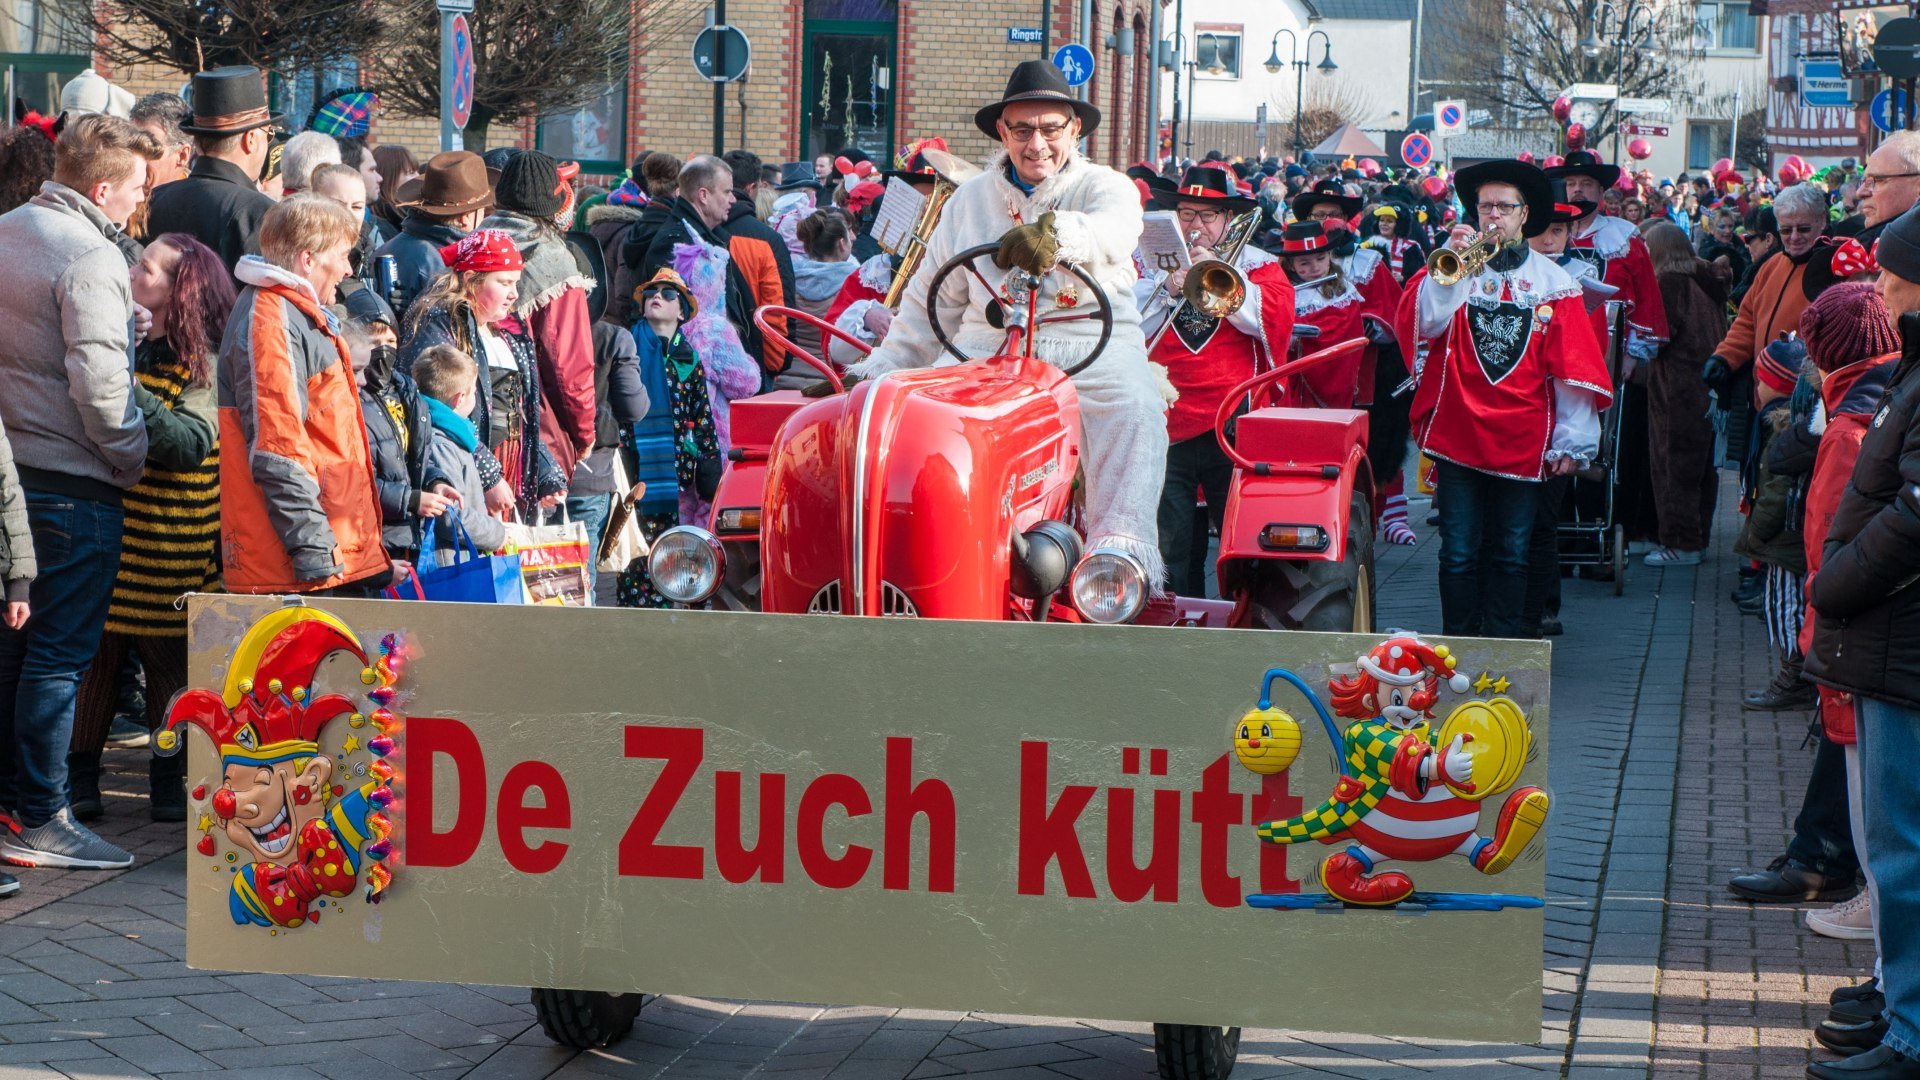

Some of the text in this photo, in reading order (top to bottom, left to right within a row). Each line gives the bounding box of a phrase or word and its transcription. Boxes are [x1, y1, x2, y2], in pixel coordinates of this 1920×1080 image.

[1817, 80, 1848, 89] Herme
[404, 717, 1303, 911] De Zuch kütt
